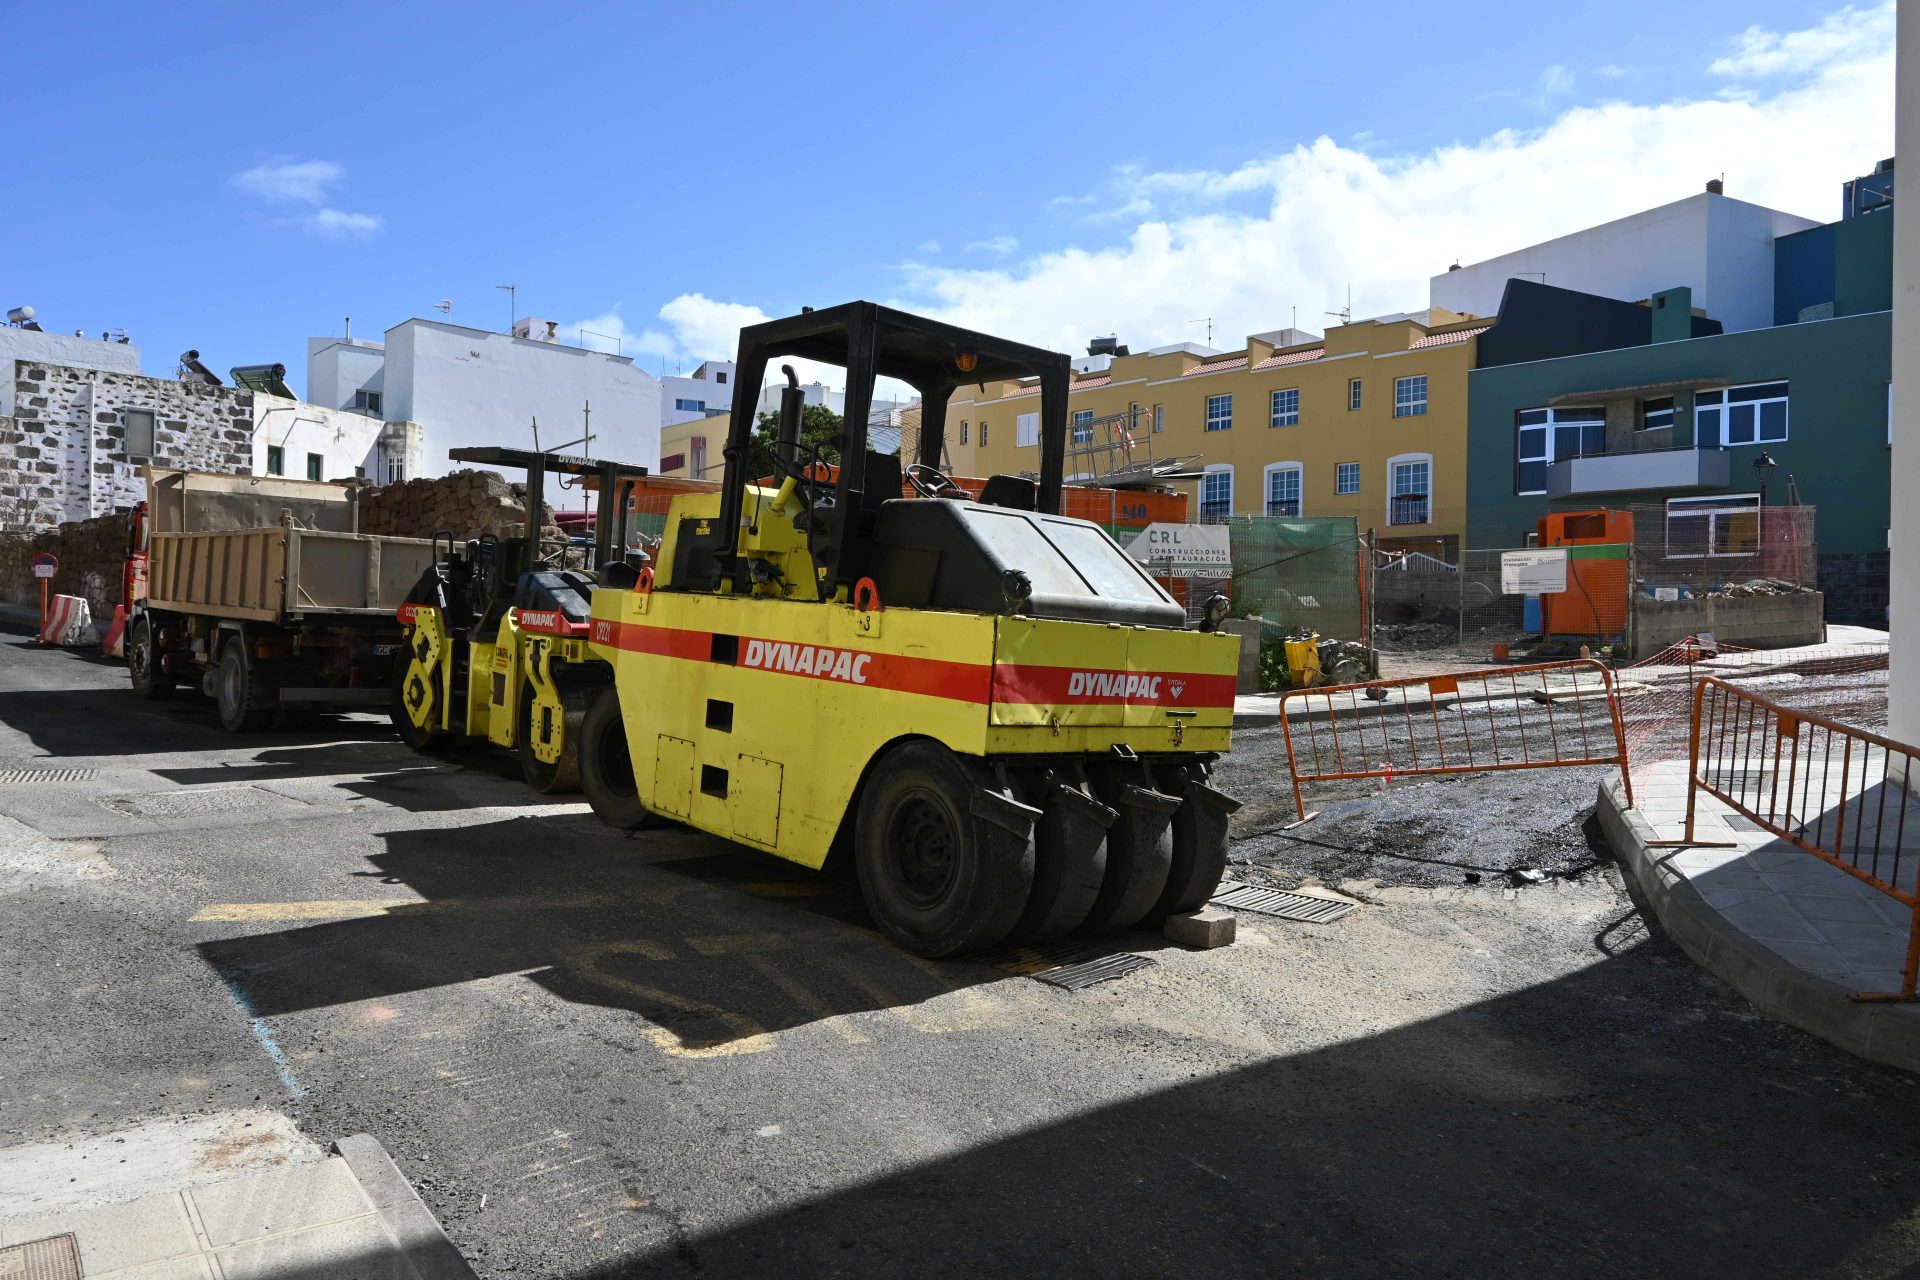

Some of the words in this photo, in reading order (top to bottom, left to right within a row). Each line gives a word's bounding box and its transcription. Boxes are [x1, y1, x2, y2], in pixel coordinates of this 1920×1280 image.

[558, 455, 598, 467] DYNAPAC
[1150, 530, 1181, 544] CRL
[1149, 548, 1226, 556] CONSTRUCCIONES
[521, 612, 555, 627] DYNAPAC
[596, 621, 611, 643] CP221
[744, 639, 872, 684] DYNAPAC
[1067, 672, 1162, 699] DYNAPAC
